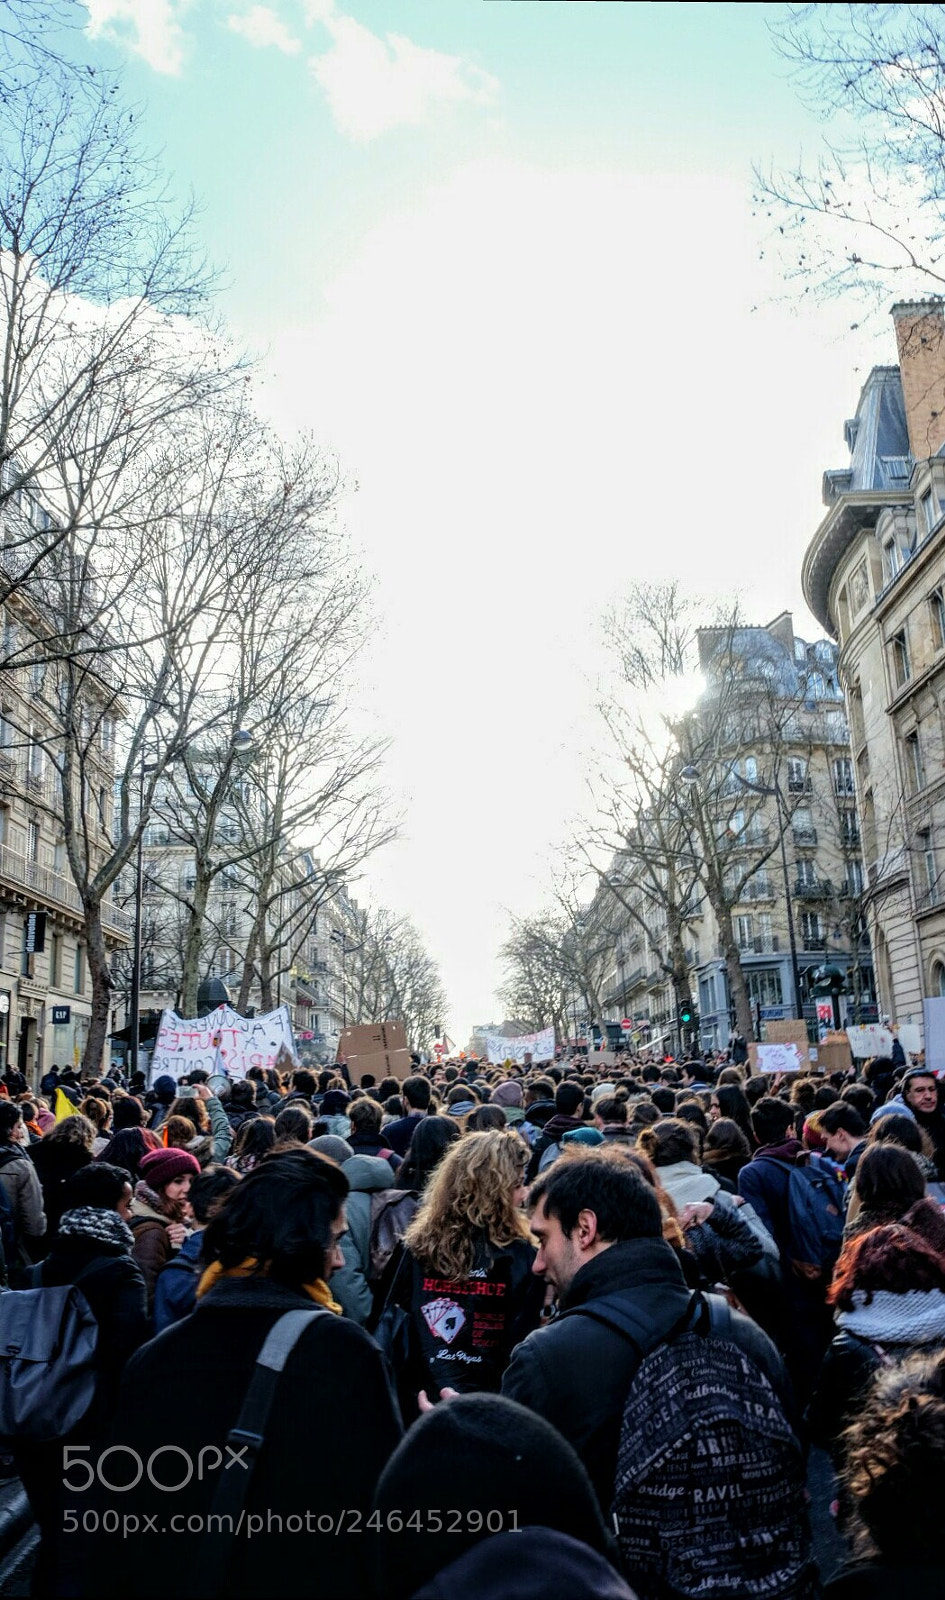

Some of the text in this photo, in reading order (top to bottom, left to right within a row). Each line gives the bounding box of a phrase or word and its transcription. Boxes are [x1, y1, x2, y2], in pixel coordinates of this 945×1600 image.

[55, 1010, 67, 1019] GAP
[436, 1349, 484, 1364] Las Vegas
